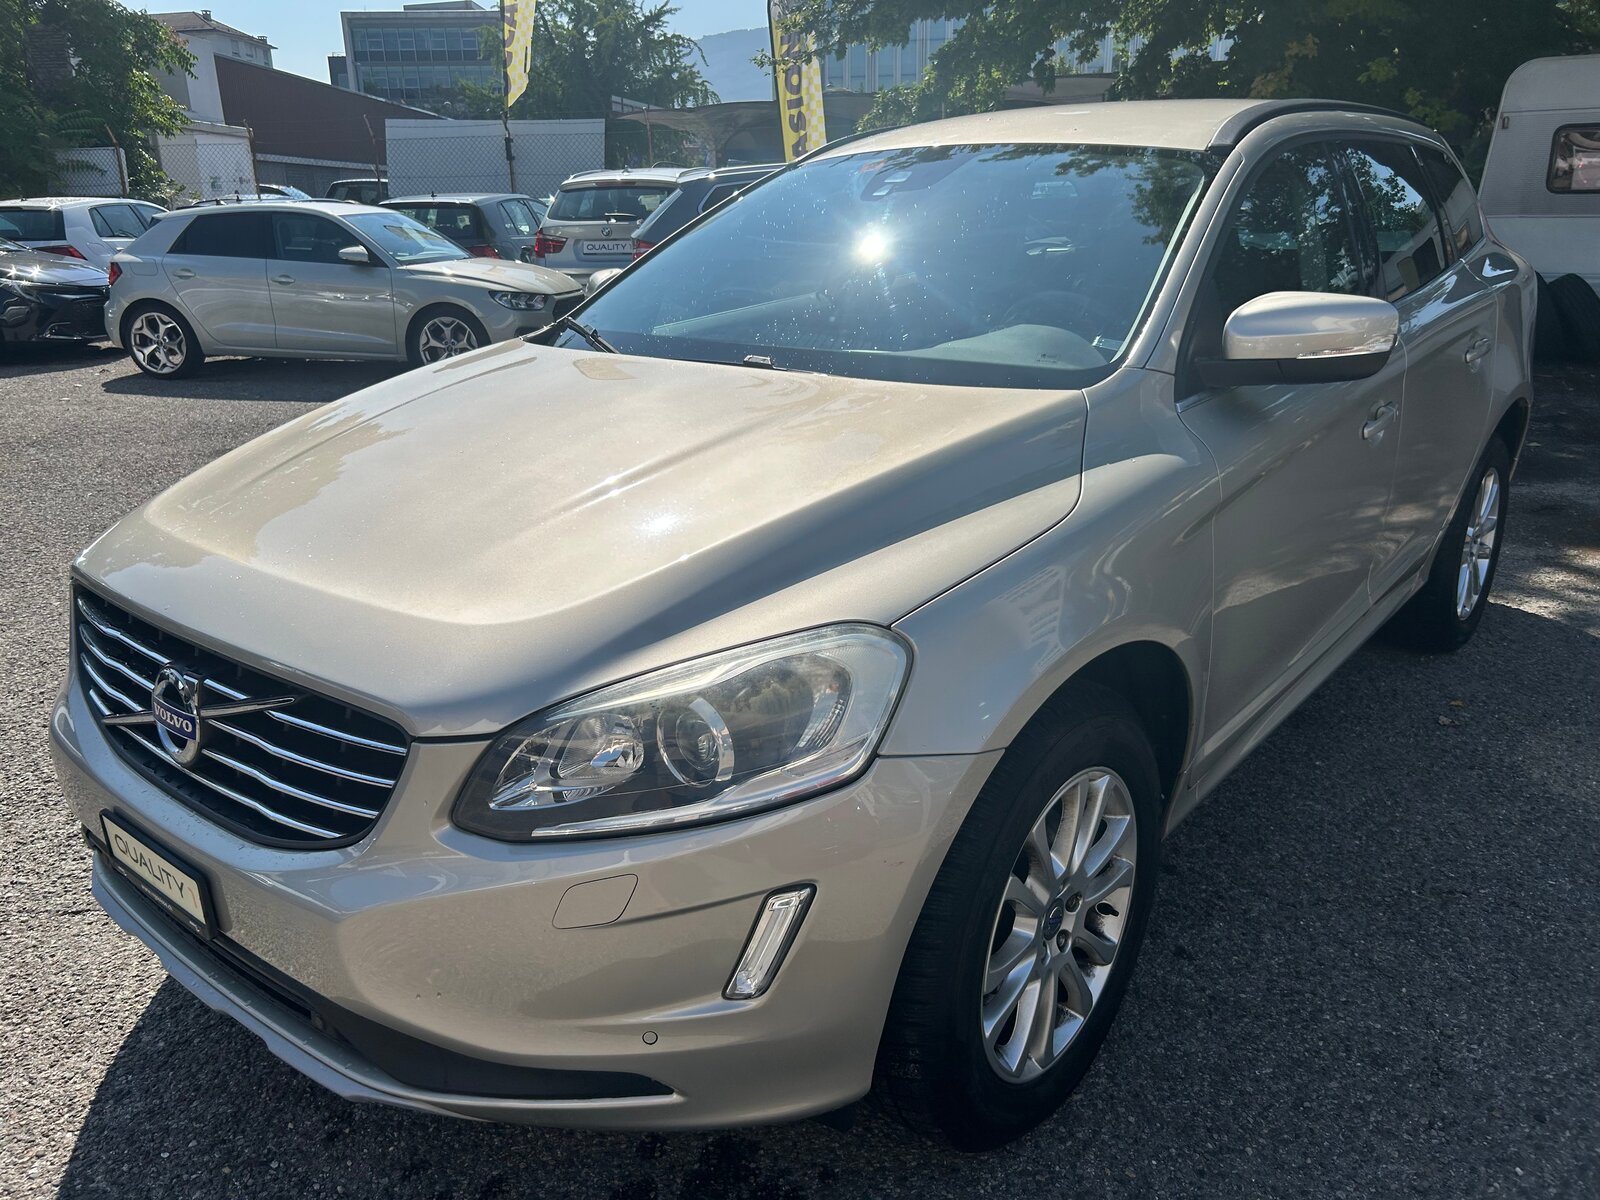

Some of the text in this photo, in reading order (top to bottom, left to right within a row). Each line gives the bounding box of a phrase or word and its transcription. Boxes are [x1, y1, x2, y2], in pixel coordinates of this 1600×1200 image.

[586, 243, 627, 251] QUALITY
[153, 701, 193, 732] VOLVO
[114, 834, 185, 898] QUALITY
